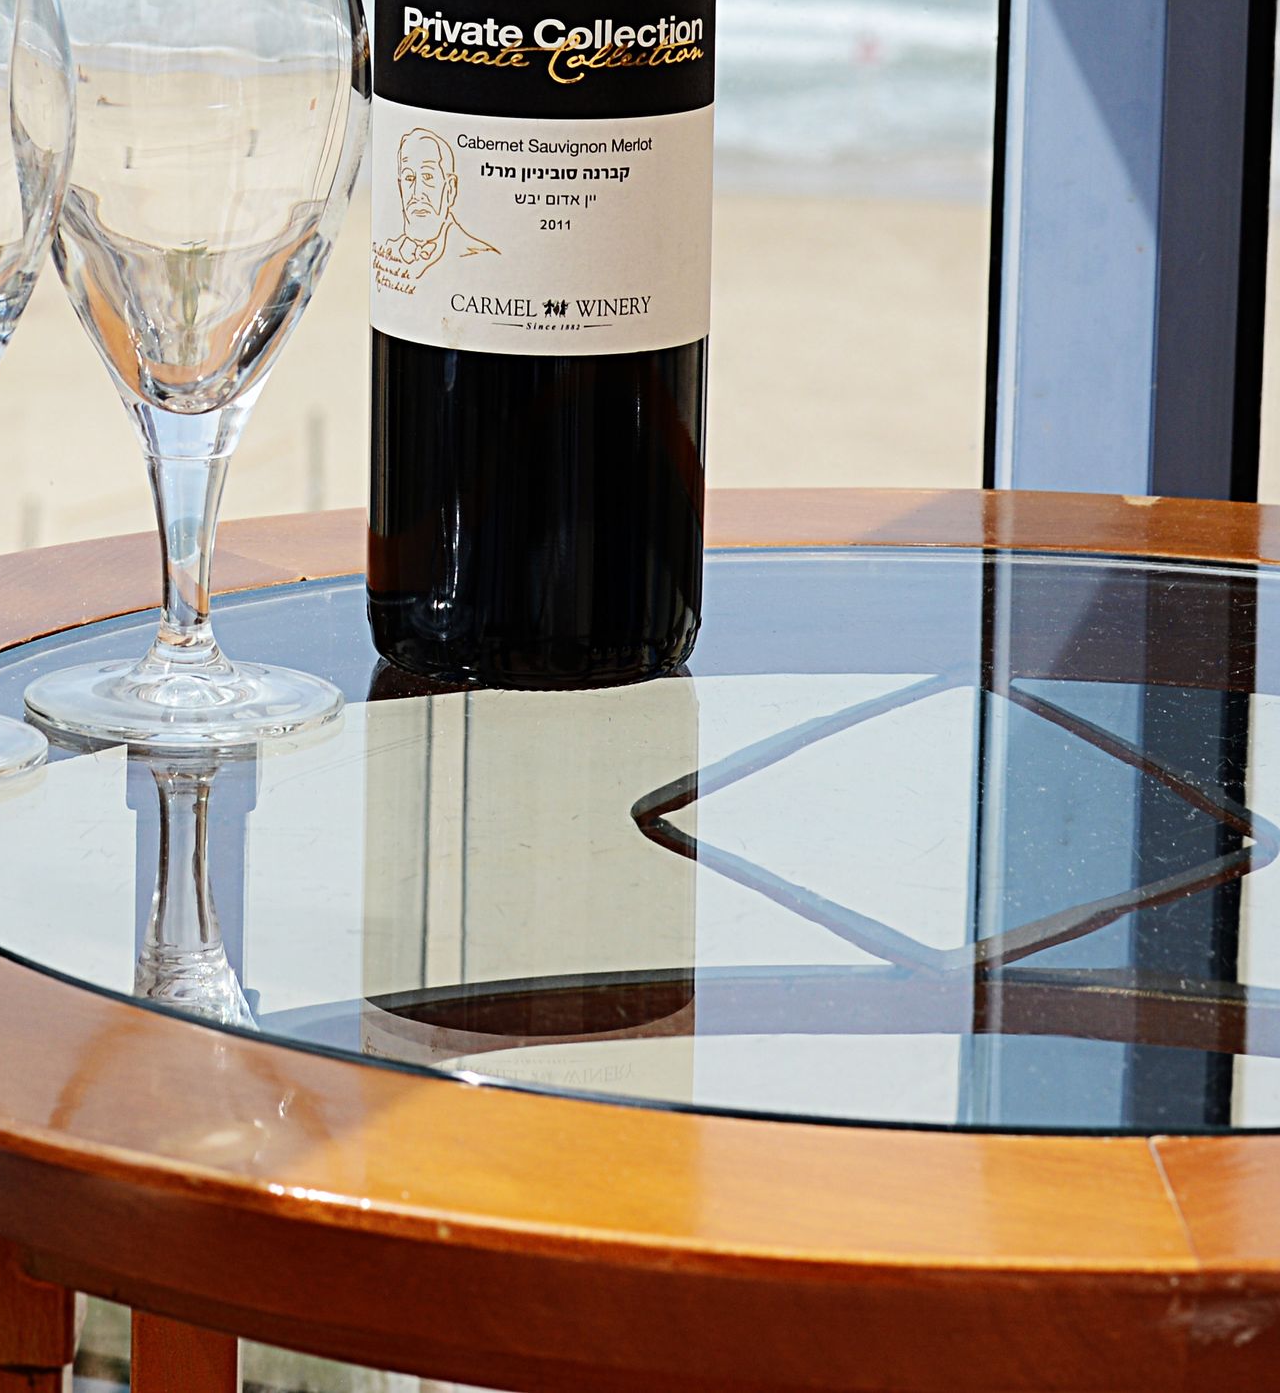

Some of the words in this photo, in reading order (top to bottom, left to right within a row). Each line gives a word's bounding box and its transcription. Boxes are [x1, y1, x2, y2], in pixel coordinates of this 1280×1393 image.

[403, 6, 523, 47] Private
[533, 15, 704, 49] Collection
[393, 26, 531, 68] Private
[547, 33, 705, 84] Collection
[456, 133, 524, 153] Cabernet
[528, 138, 607, 157] Sauvignon
[611, 137, 653, 153] Merlot
[480, 162, 517, 179] מרלו
[521, 166, 578, 183] סוביניון
[582, 166, 631, 183] קברנה
[514, 193, 541, 206] יבש
[545, 193, 581, 206] אדום
[584, 194, 597, 209] יין
[539, 219, 571, 231] 2011
[450, 293, 538, 318] CARMEL
[575, 295, 652, 318] WINERY
[526, 321, 556, 331] Since
